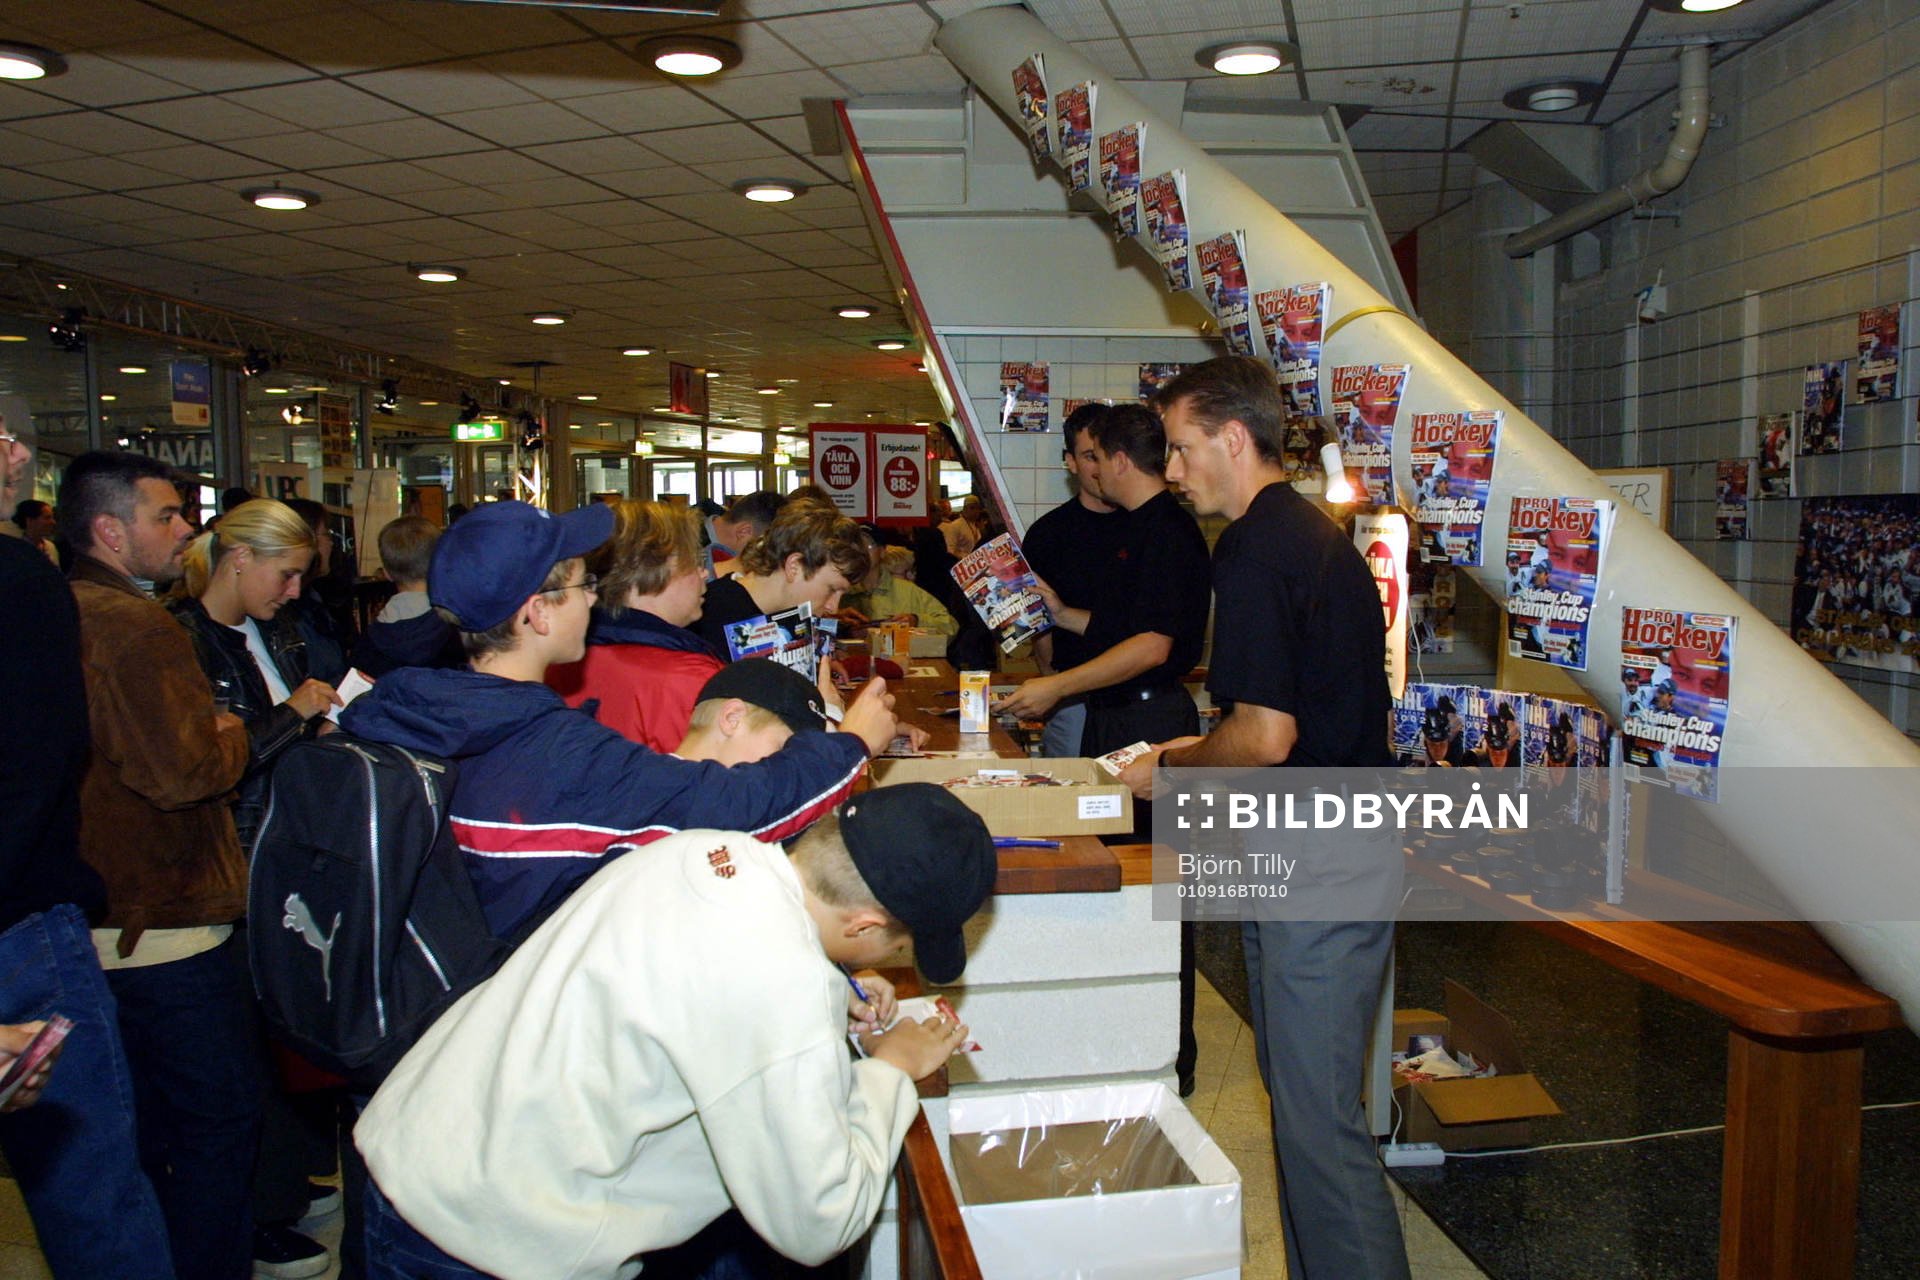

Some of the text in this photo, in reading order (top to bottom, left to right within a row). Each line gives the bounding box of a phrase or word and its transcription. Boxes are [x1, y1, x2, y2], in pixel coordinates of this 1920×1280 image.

[1331, 365, 1404, 396] Hockey
[1430, 413, 1454, 424] PRO
[1411, 412, 1496, 448] Hockey
[825, 449, 855, 462] TÄVLA
[881, 443, 920, 454] Erbjudande!
[831, 463, 850, 474] OCH
[897, 459, 904, 470] 4
[829, 475, 852, 486] VINN
[1459, 496, 1479, 511] Cup
[1523, 498, 1550, 509] PRO
[1416, 507, 1484, 525] champions
[953, 541, 1014, 586] Hockey
[1523, 589, 1584, 608] Stanley Cup
[1508, 597, 1589, 623] champions
[1644, 610, 1674, 624] PRO
[1621, 608, 1728, 659] Hockey
[1641, 709, 1714, 735] Stanley Cup
[1623, 719, 1721, 753] champions
